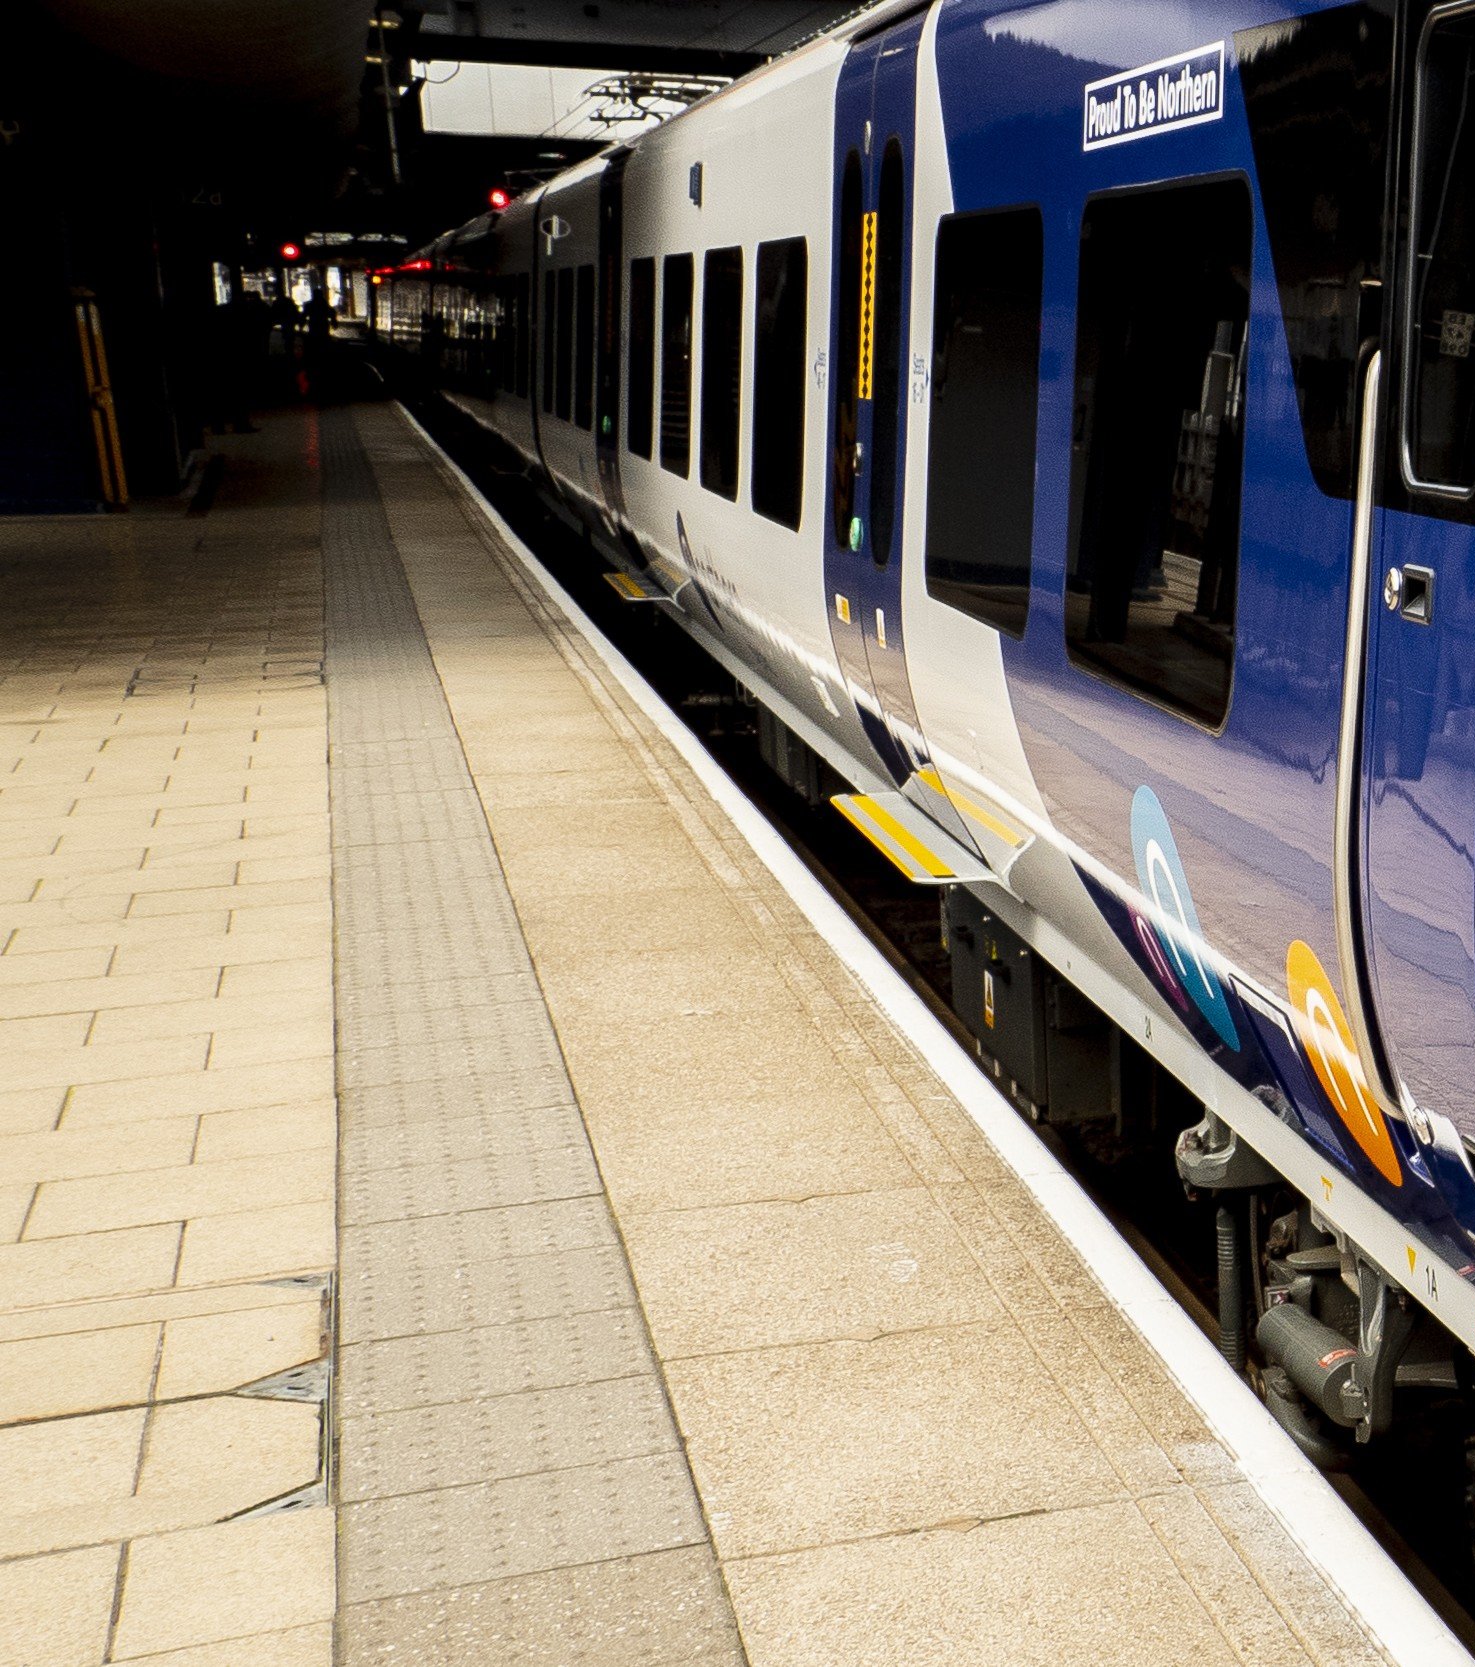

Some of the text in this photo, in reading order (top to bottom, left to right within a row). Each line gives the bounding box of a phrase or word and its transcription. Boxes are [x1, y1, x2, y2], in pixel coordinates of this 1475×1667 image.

[1089, 63, 1217, 139] Proud To Be Northern
[1425, 1264, 1438, 1302] 1A
